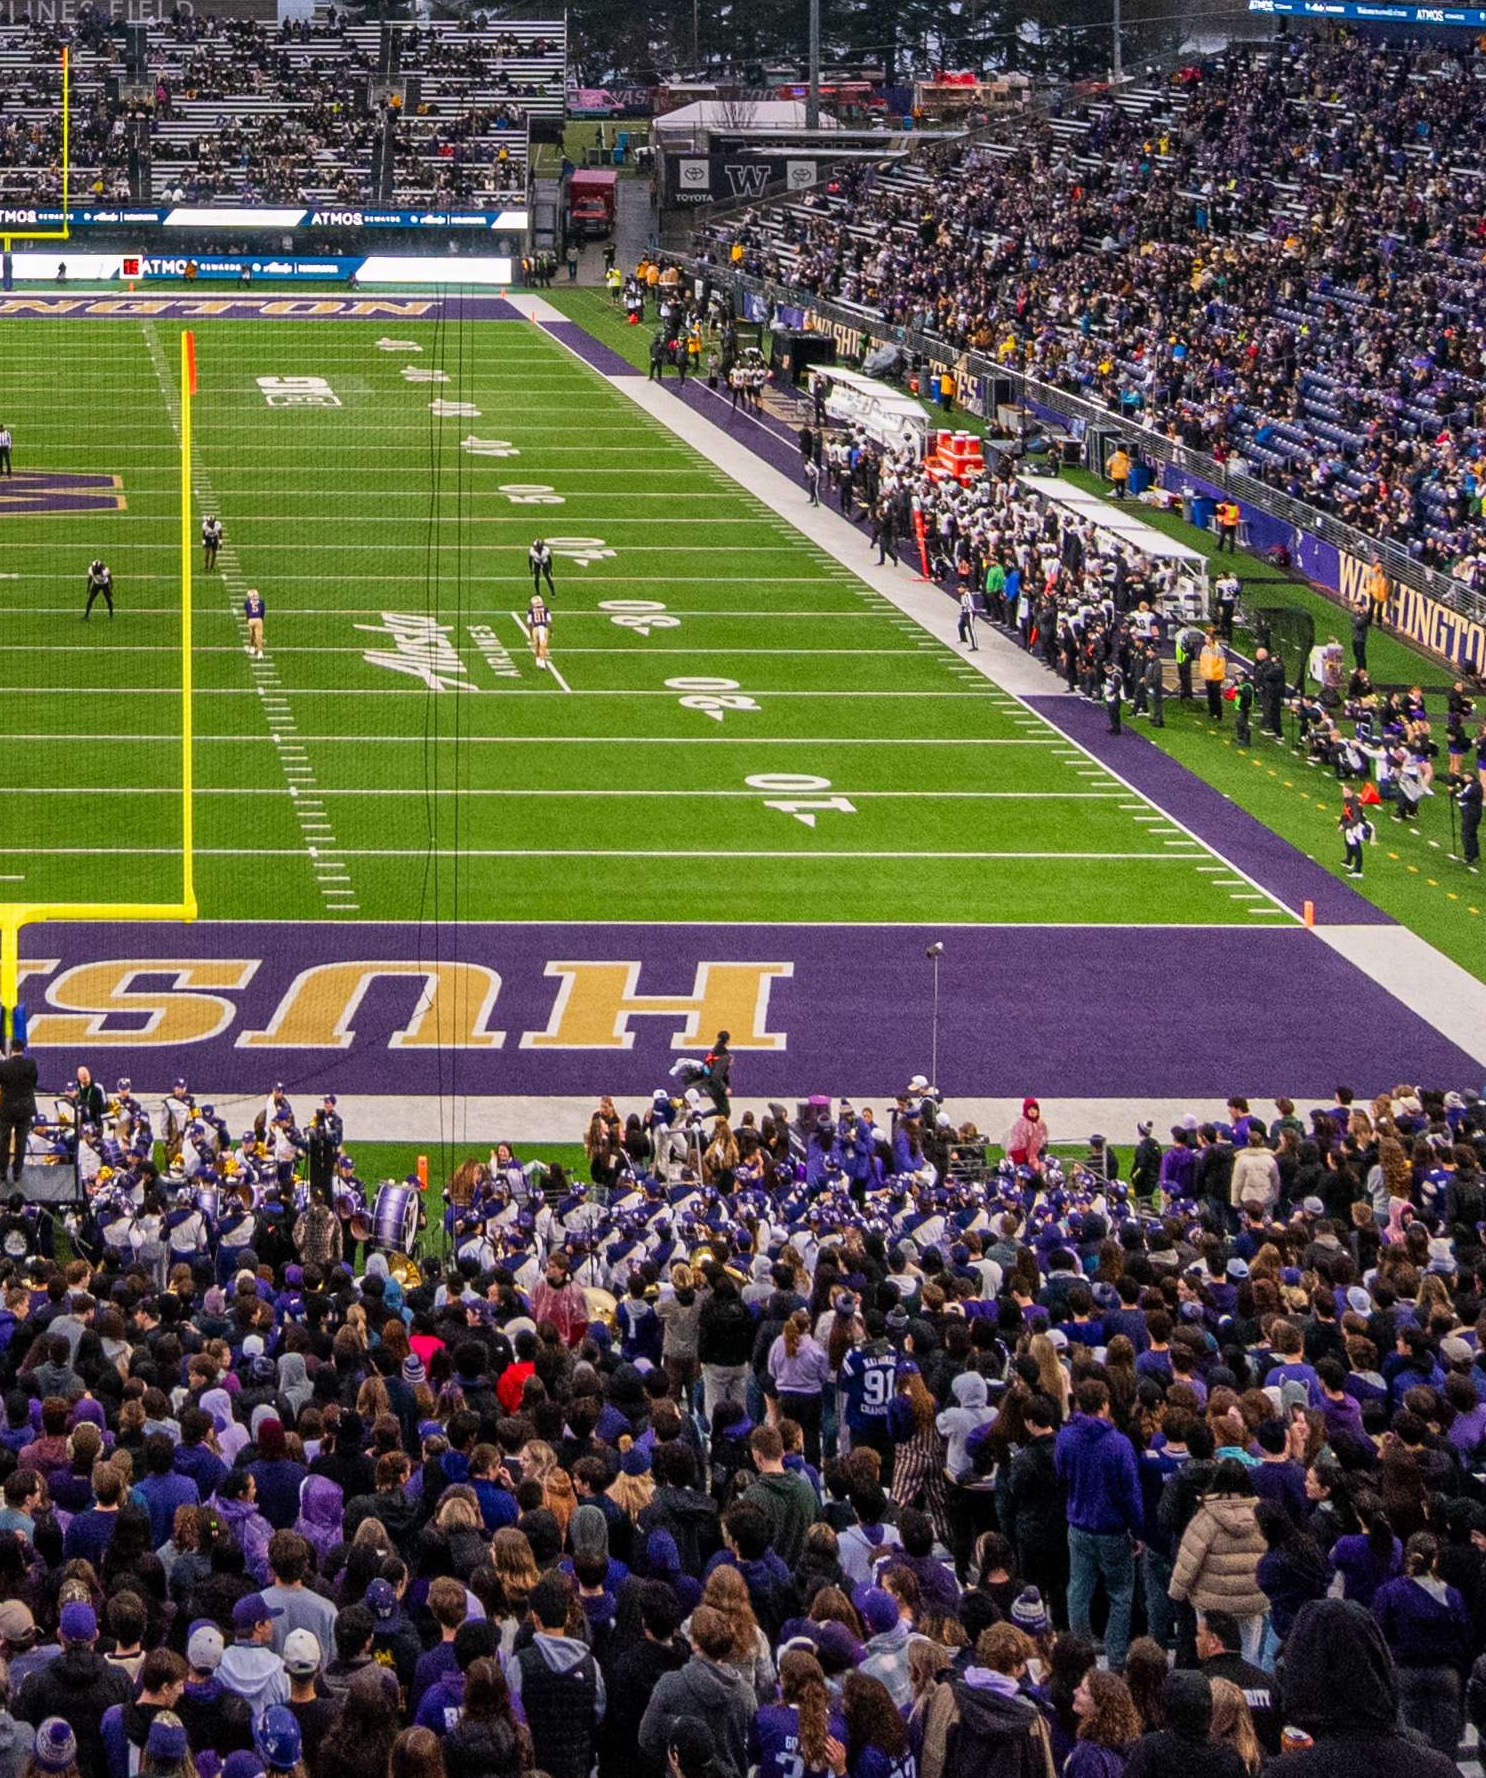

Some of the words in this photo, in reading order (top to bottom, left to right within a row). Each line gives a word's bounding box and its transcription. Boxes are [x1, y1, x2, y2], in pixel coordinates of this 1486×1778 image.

[110, 0, 193, 25] FIELD
[725, 166, 771, 197] W
[676, 193, 714, 203] TOYOTA
[311, 213, 364, 227] ATMOS
[123, 260, 140, 278] 15
[498, 484, 566, 504] 50
[597, 599, 682, 628] 30
[353, 612, 479, 691] Alaska
[664, 676, 762, 711] 20
[744, 773, 858, 813] 10
[862, 1369, 897, 1406] 91
